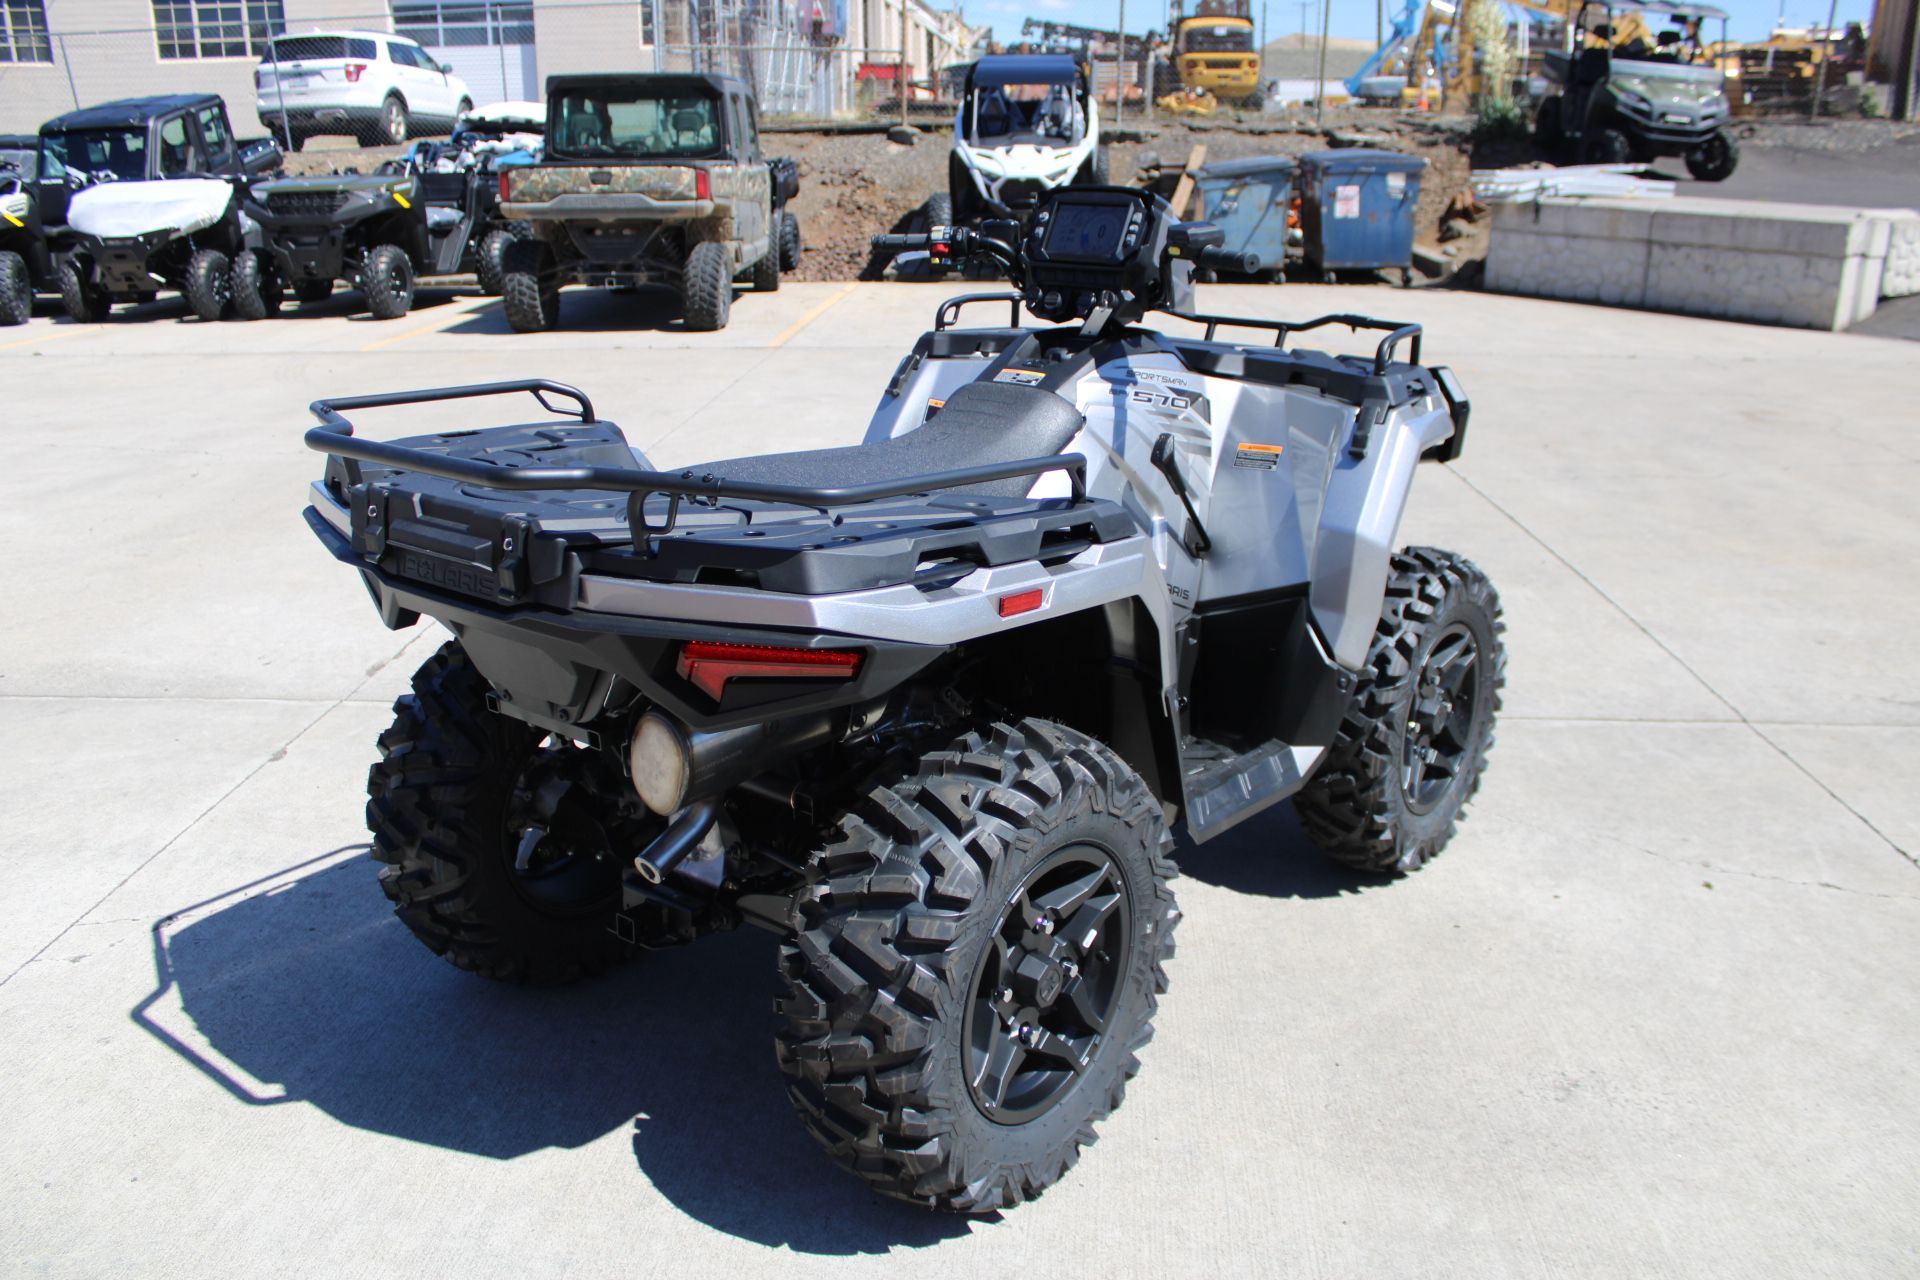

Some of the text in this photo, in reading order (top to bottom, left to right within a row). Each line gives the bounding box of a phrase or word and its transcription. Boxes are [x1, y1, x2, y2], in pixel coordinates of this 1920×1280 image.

[1126, 369, 1188, 386] SPORTSMAN
[1132, 390, 1189, 409] 570
[401, 555, 497, 597] POLARIS
